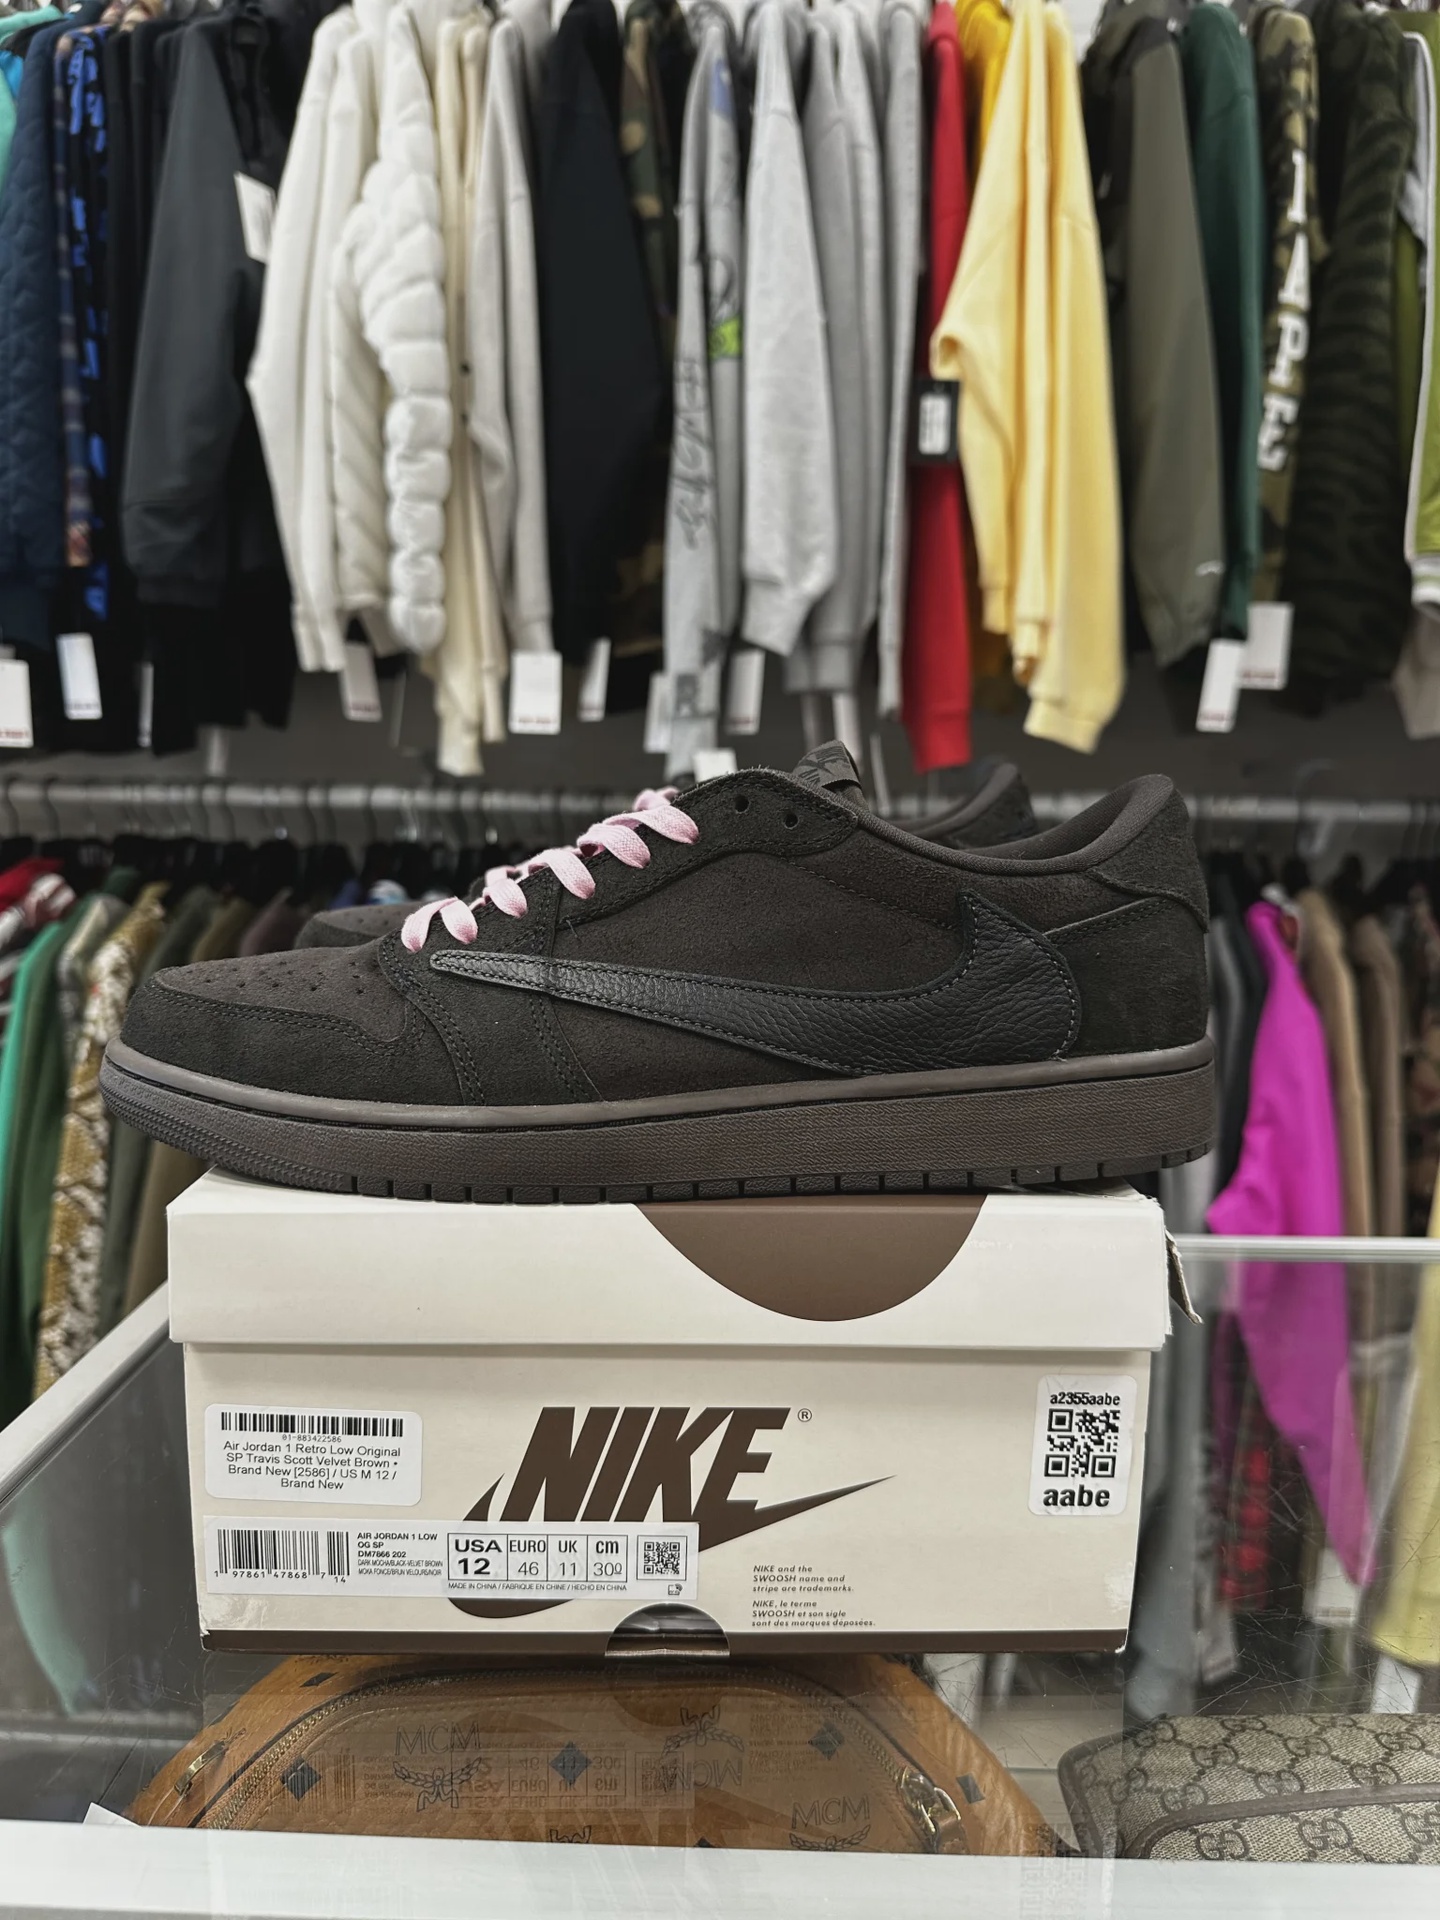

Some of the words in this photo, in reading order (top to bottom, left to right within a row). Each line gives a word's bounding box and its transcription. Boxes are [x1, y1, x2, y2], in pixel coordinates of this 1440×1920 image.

[1050, 1391, 1121, 1406] a2355aabe
[281, 1434, 342, 1443] 01-883422586
[223, 1440, 239, 1451] Air
[243, 1442, 281, 1453] Jordan
[286, 1443, 291, 1453] 1
[295, 1444, 326, 1454] Retro
[330, 1445, 353, 1456] Low
[357, 1446, 401, 1459] Original
[226, 1453, 243, 1463] SP
[246, 1453, 280, 1464] Travis
[284, 1454, 313, 1465] Scott
[316, 1456, 350, 1467] Velvet
[355, 1457, 390, 1468] Brown
[500, 1406, 791, 1521] NIKE
[228, 1465, 262, 1475] Brand
[265, 1466, 291, 1476] New
[294, 1467, 330, 1480] [2586]
[340, 1469, 357, 1479] US
[361, 1470, 371, 1479] M
[376, 1470, 390, 1480] 12
[281, 1478, 315, 1489] Brand
[318, 1479, 344, 1490] New
[1043, 1484, 1110, 1507] aabe
[357, 1532, 372, 1540] AIR
[373, 1532, 409, 1540] JORDAN
[357, 1541, 371, 1549] OG
[372, 1541, 384, 1549] SP
[454, 1539, 503, 1553] USA
[509, 1539, 547, 1553] EURO
[558, 1540, 578, 1553] UK
[595, 1540, 619, 1554] cm
[357, 1550, 391, 1558] DM7866
[458, 1558, 491, 1575] 12
[518, 1561, 539, 1576] 46
[559, 1562, 577, 1577] 11
[753, 1565, 775, 1573] NIKE
[777, 1565, 796, 1573] and
[798, 1565, 813, 1573] the
[232, 1570, 266, 1579] 97861
[273, 1571, 308, 1580] 47868
[753, 1574, 796, 1582] SWOOSH
[502, 1583, 534, 1591] FABRIQUE
[753, 1584, 779, 1593] stripe
[799, 1584, 854, 1592] trademarks.
[752, 1600, 778, 1608] NIKE,
[790, 1600, 817, 1608] terme
[752, 1610, 795, 1618] SWOOSH
[825, 1610, 847, 1618] sigle
[751, 1619, 771, 1627] sont
[773, 1619, 789, 1627] des
[791, 1620, 831, 1628] marques
[393, 1720, 482, 1756] MCM
[791, 1796, 871, 1831] MCM
